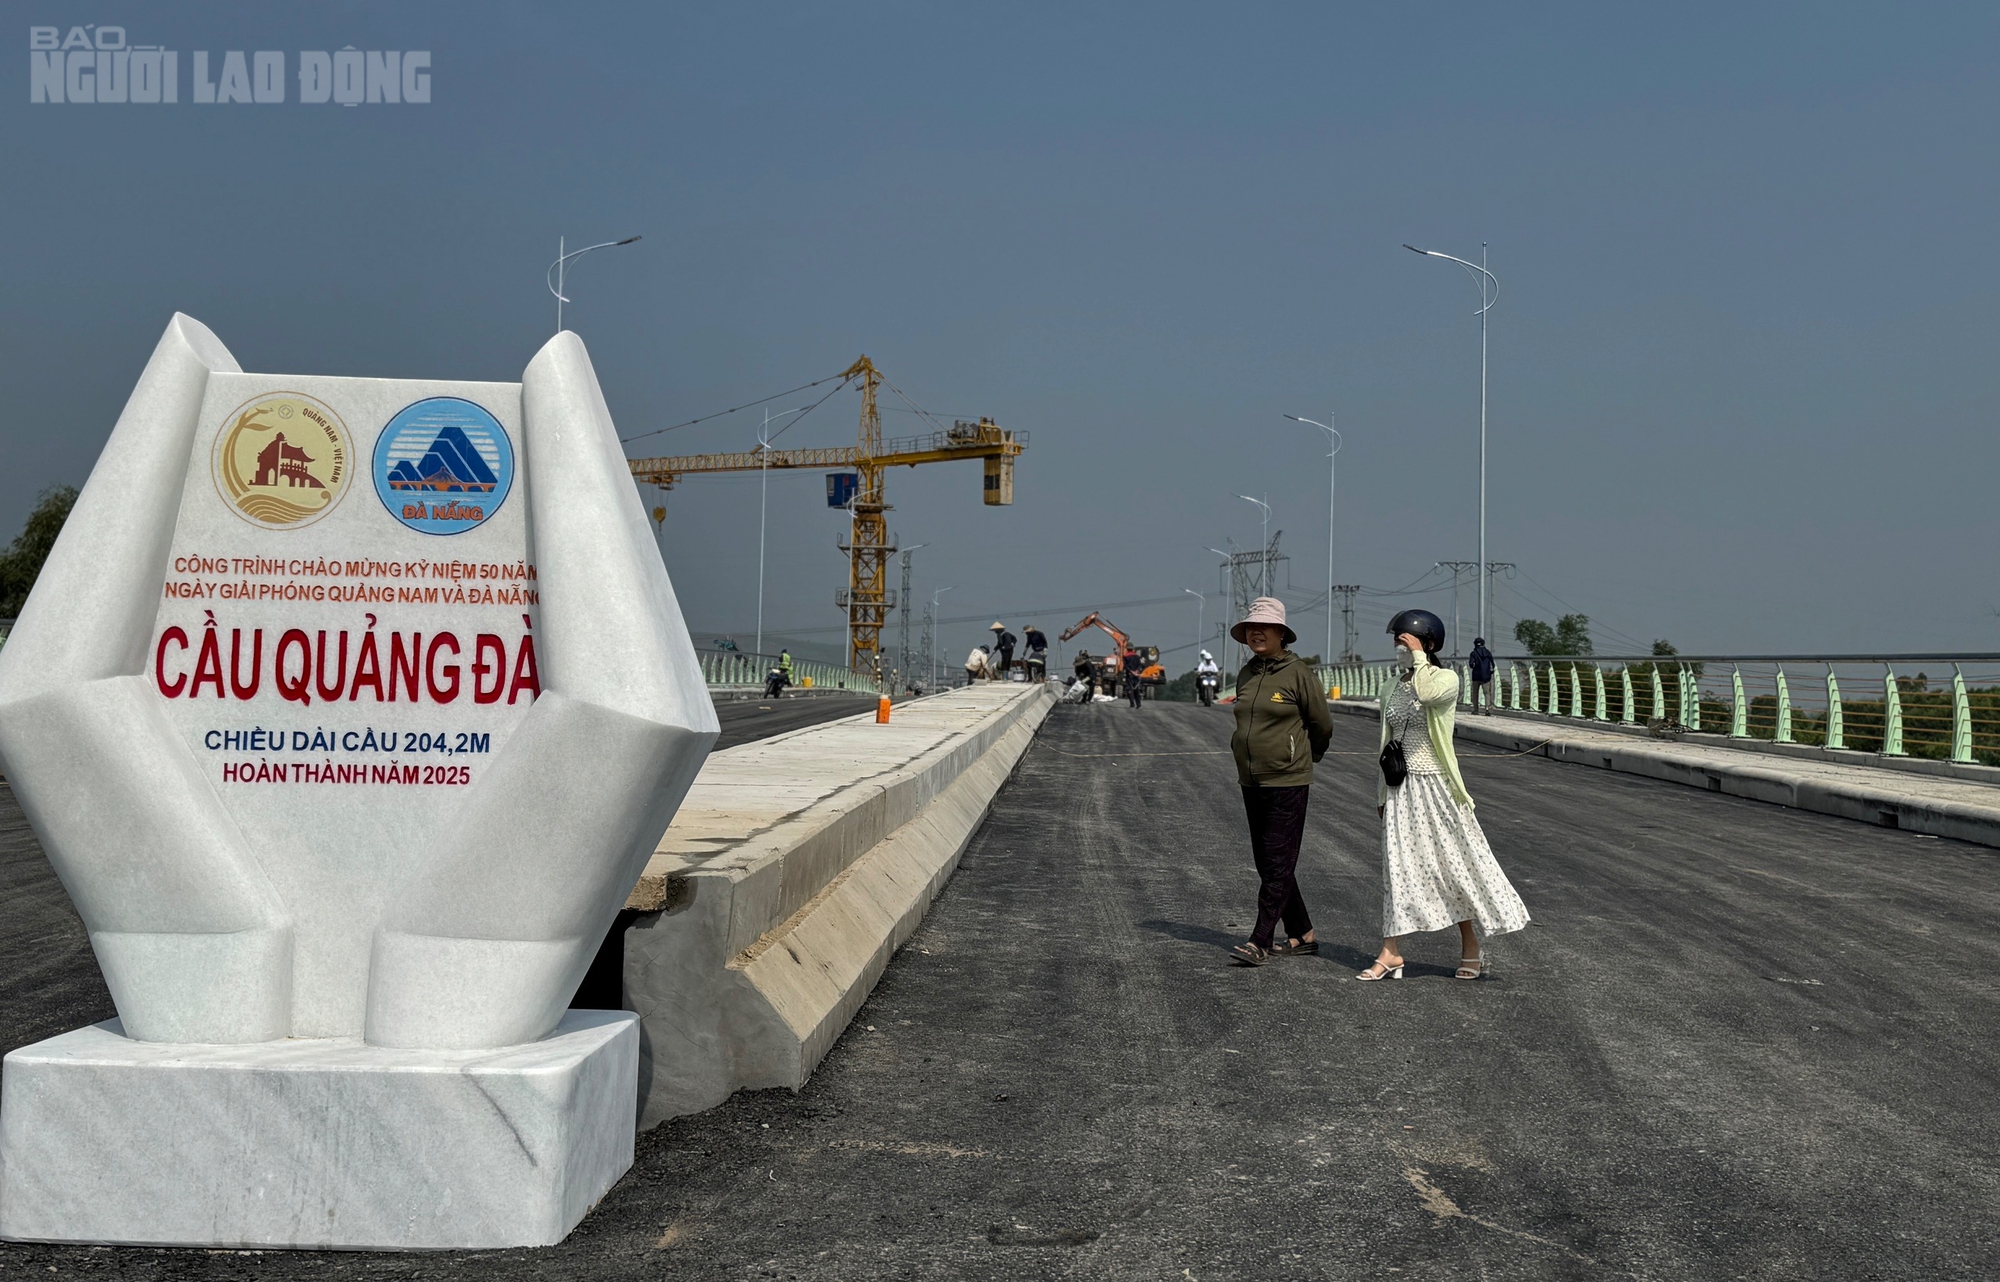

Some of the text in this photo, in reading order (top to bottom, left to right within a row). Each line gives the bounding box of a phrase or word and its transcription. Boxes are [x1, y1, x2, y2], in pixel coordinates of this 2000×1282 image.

[302, 407, 327, 427] QUẢNG
[323, 425, 338, 443] NAM
[333, 448, 344, 465] VIỆT
[330, 465, 342, 483] NAM
[402, 501, 428, 519] ĐÀ
[175, 554, 228, 574] CÔNG
[231, 555, 286, 575] TRÌNH
[289, 556, 342, 577] CHÀO
[345, 557, 402, 578] MỪNG
[404, 558, 430, 578] KỶ
[432, 560, 476, 583] NIỆM
[480, 564, 499, 580] 50
[165, 578, 217, 599] NGÀY
[219, 579, 256, 600] GIẢI
[259, 580, 325, 601] PHÓNG
[328, 582, 395, 603] QUẢNG
[398, 587, 438, 604] NAM
[441, 584, 466, 605] VÀ
[468, 585, 494, 605] ĐÀ
[156, 609, 542, 706] CẦU QUẢNG ĐÀ
[204, 726, 490, 757] CHIỀU DÀI CẦU 204,2M
[223, 757, 471, 785] HOÀN THÀNH NĂM 2025
